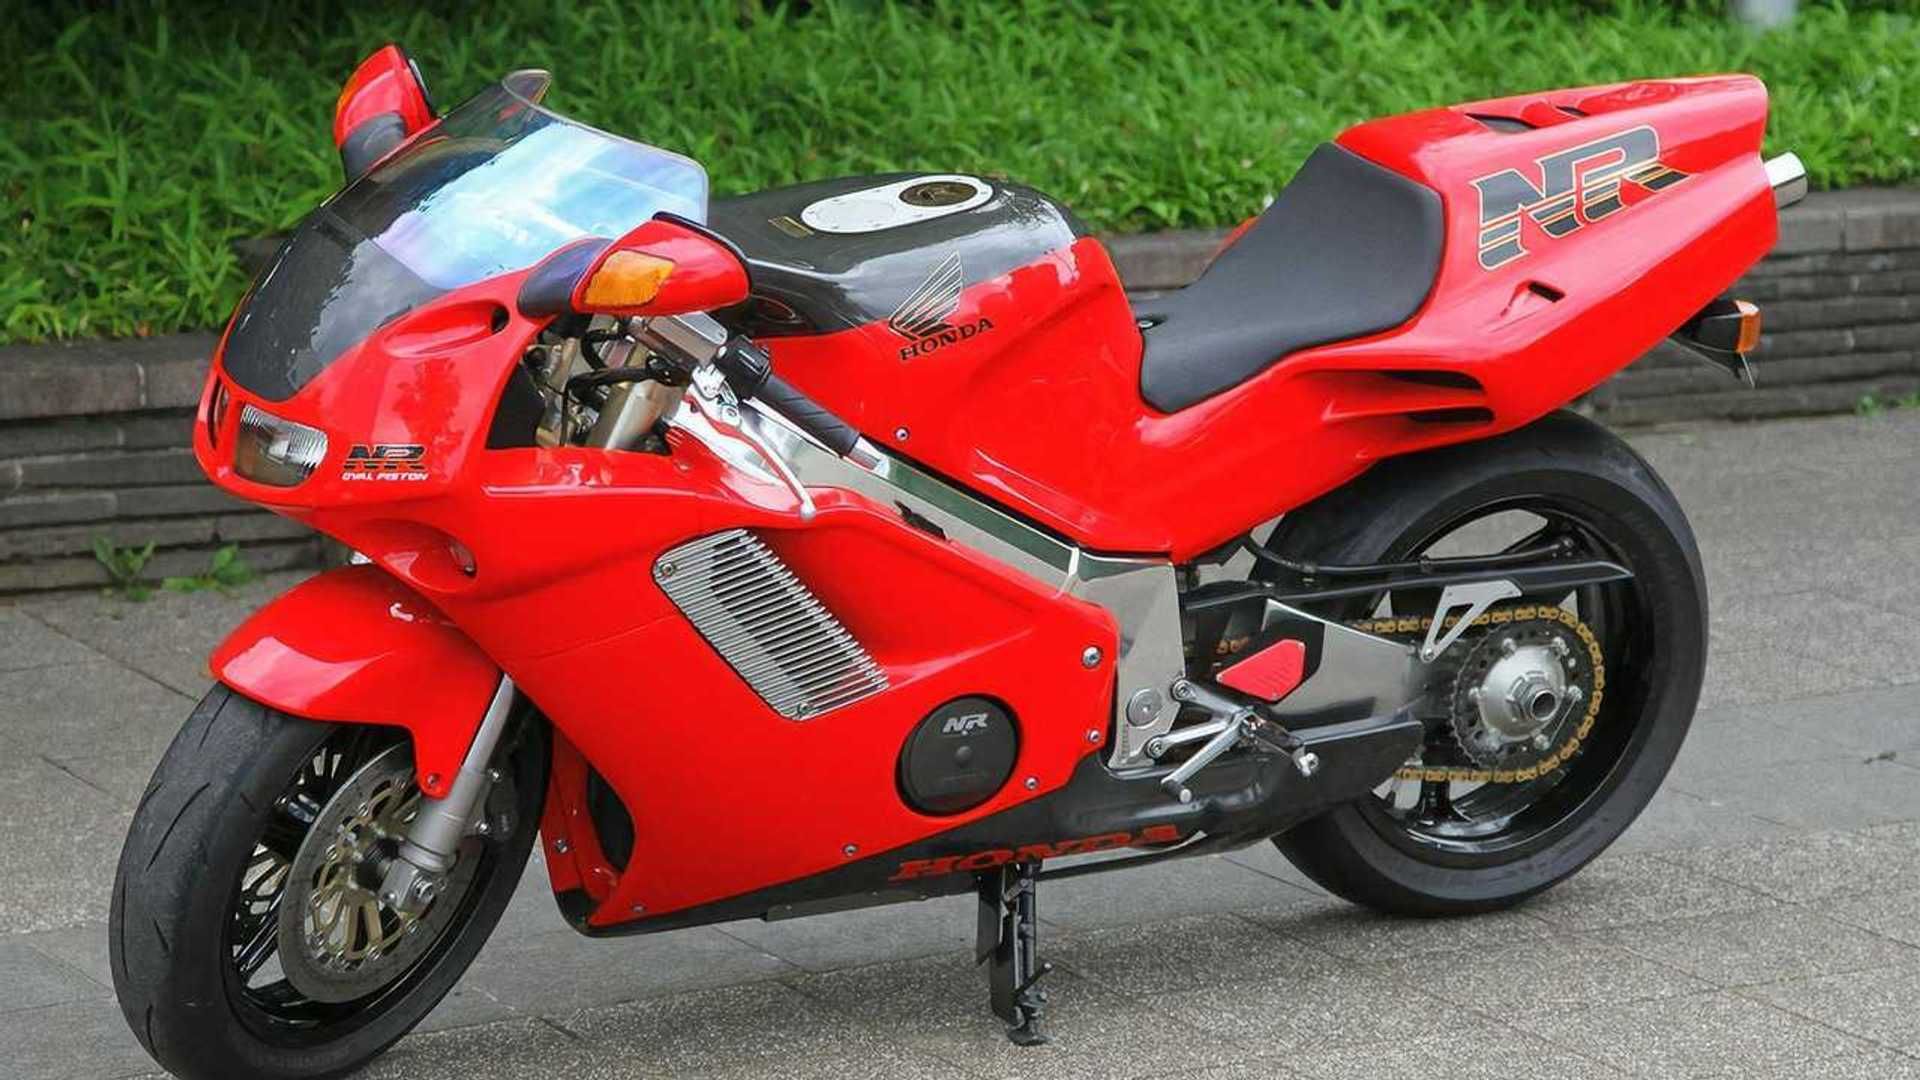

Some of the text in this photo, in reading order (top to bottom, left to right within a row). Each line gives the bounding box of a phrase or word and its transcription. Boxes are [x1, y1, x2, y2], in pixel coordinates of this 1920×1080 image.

[1470, 125, 1694, 270] NR
[900, 318, 994, 360] HONDA
[343, 444, 426, 470] NR
[342, 472, 429, 481] OVAL PISTON
[942, 713, 987, 733] NR
[890, 824, 1180, 881] HONDA
